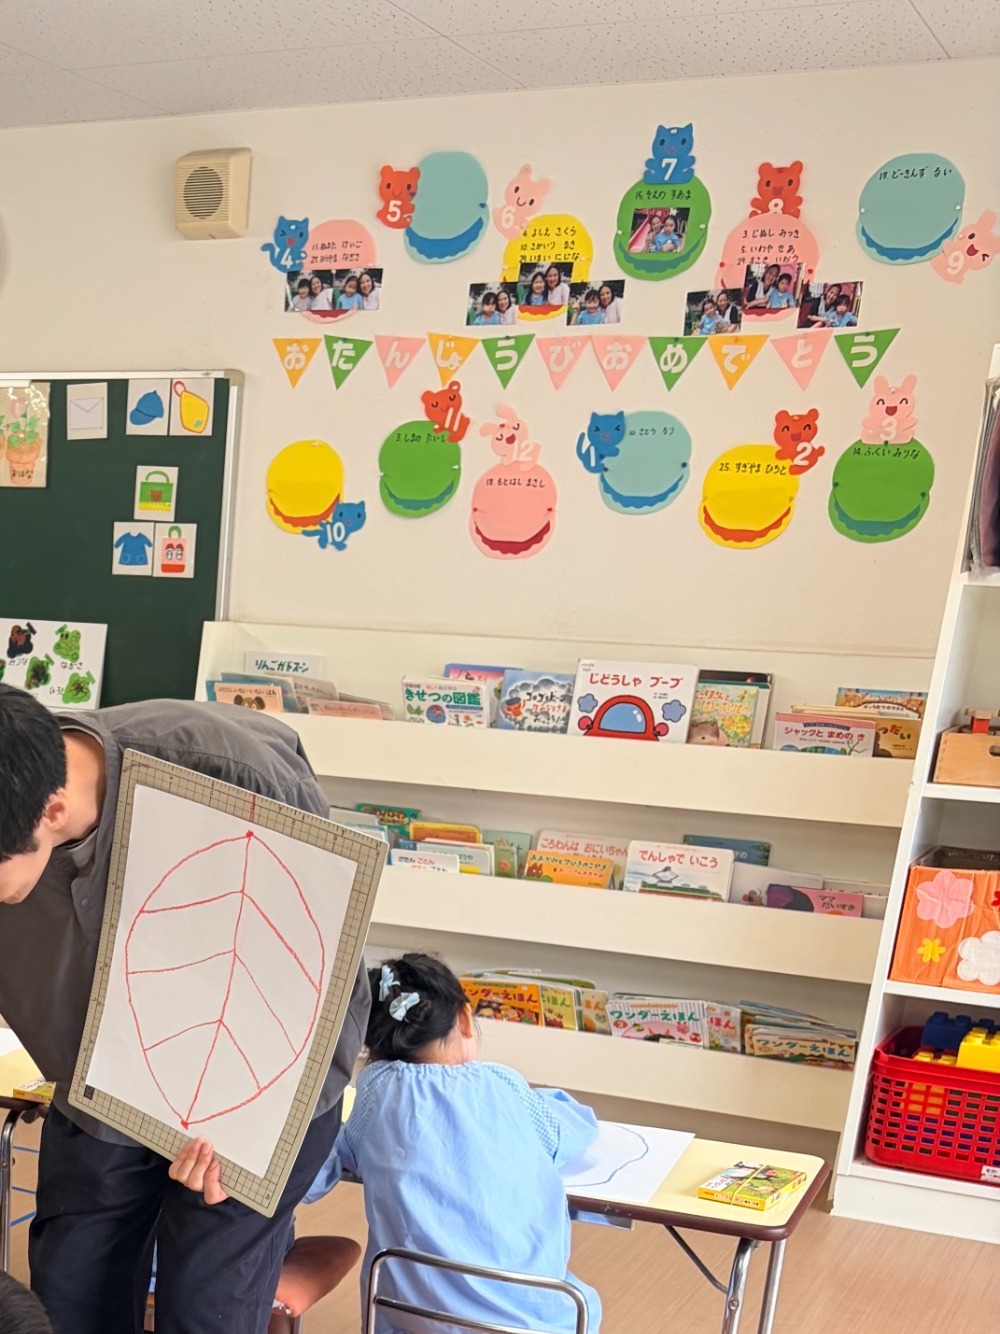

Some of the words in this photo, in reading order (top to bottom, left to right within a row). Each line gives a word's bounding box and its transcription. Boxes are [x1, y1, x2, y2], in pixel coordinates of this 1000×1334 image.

[661, 158, 678, 181] 7
[387, 200, 402, 222] 5
[501, 205, 515, 229] 6
[555, 226, 576, 237] さくら
[281, 248, 293, 269] 4
[947, 251, 965, 275] 9
[444, 407, 462, 432] 11
[880, 417, 897, 440] 3
[511, 440, 534, 462] 12
[590, 446, 596, 467] 1
[793, 442, 812, 466] 2
[326, 521, 345, 543] 10
[589, 672, 642, 688] じどうしゃ
[405, 688, 481, 706] きせつの図鑑
[784, 726, 824, 738] ジャックと
[827, 730, 853, 740] まめの
[584, 843, 628, 857] おにいちゃん
[640, 850, 685, 864] でんしゃで
[690, 855, 718, 868] いこう
[610, 1010, 699, 1022] ワンダーえほん
[757, 1039, 850, 1058] ワンダーえほん
